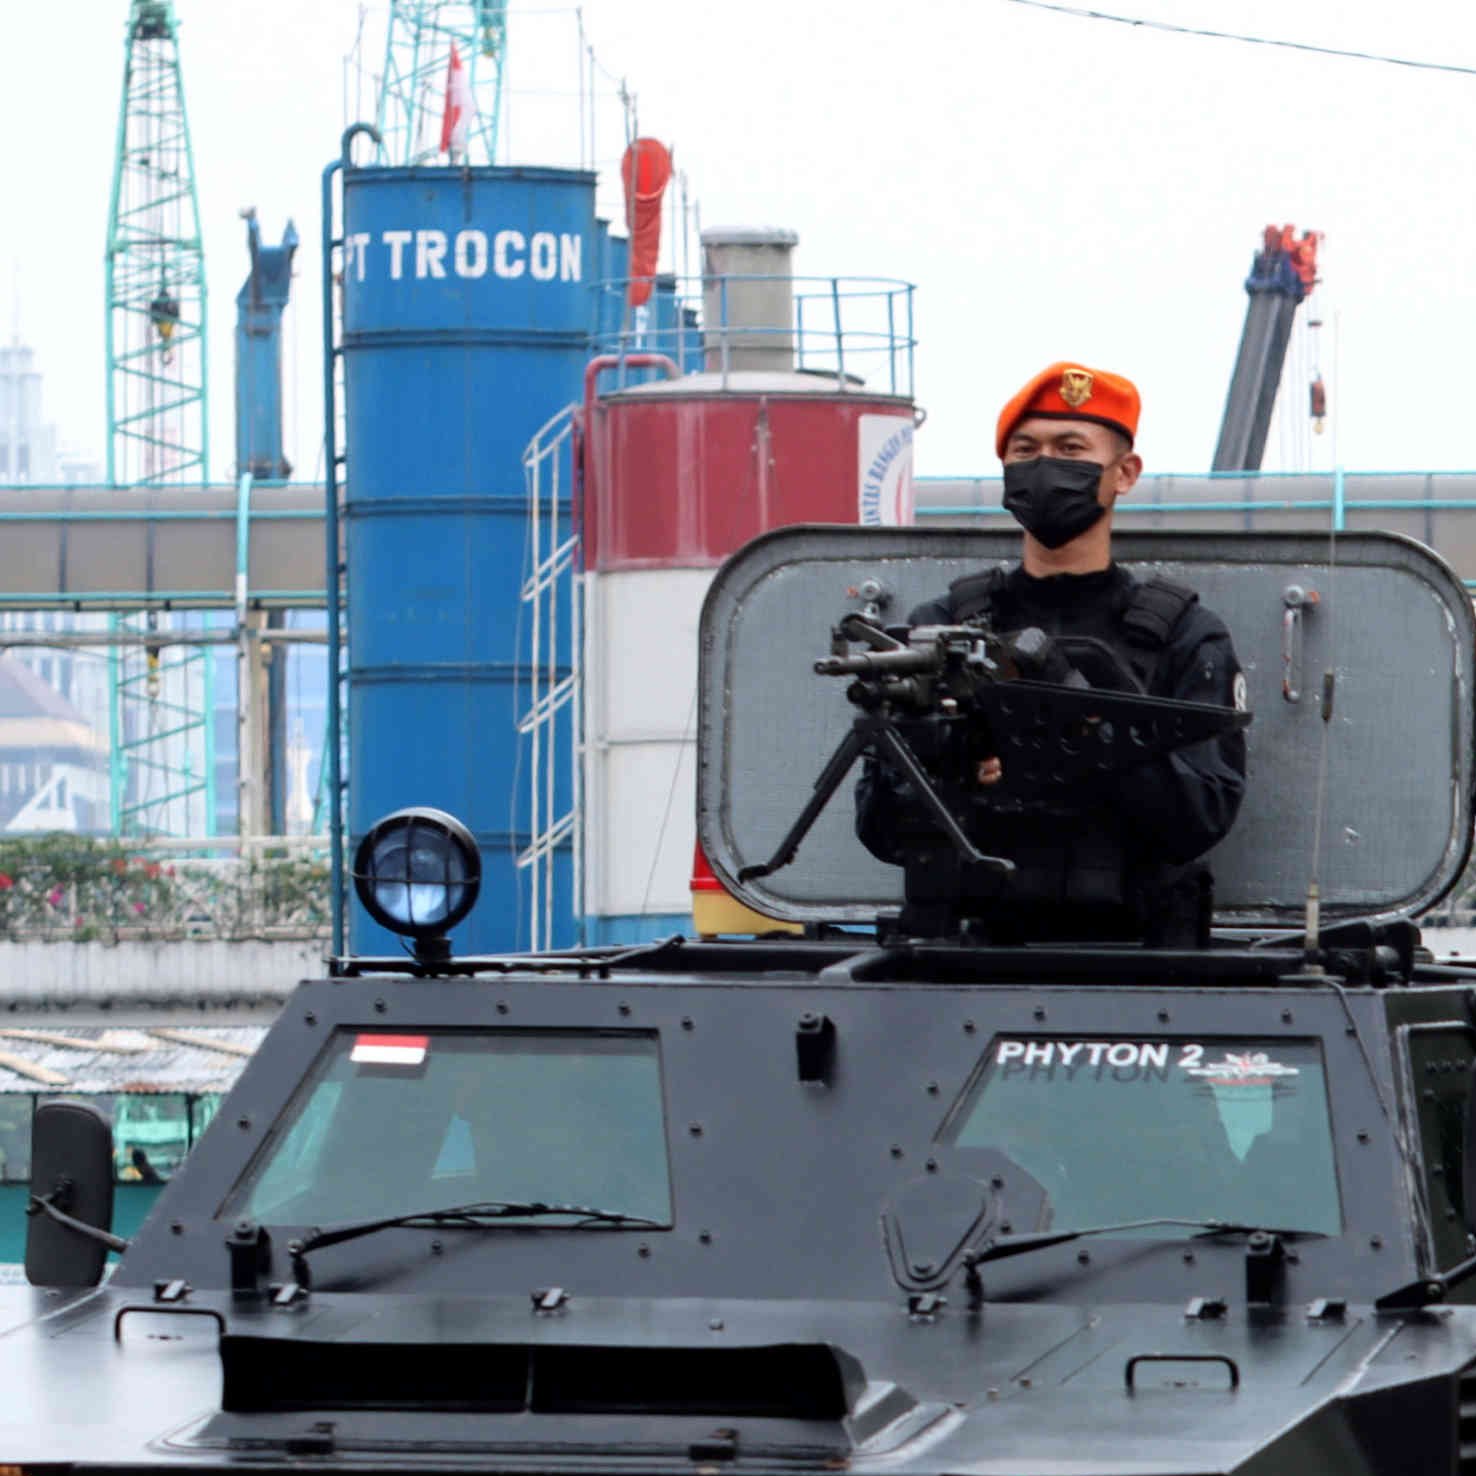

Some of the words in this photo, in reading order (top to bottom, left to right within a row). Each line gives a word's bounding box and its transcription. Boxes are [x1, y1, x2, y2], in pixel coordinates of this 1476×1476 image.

[382, 230, 582, 283] TROCON
[996, 1041, 1169, 1068] PHYTON
[1177, 1044, 1205, 1068] 2
